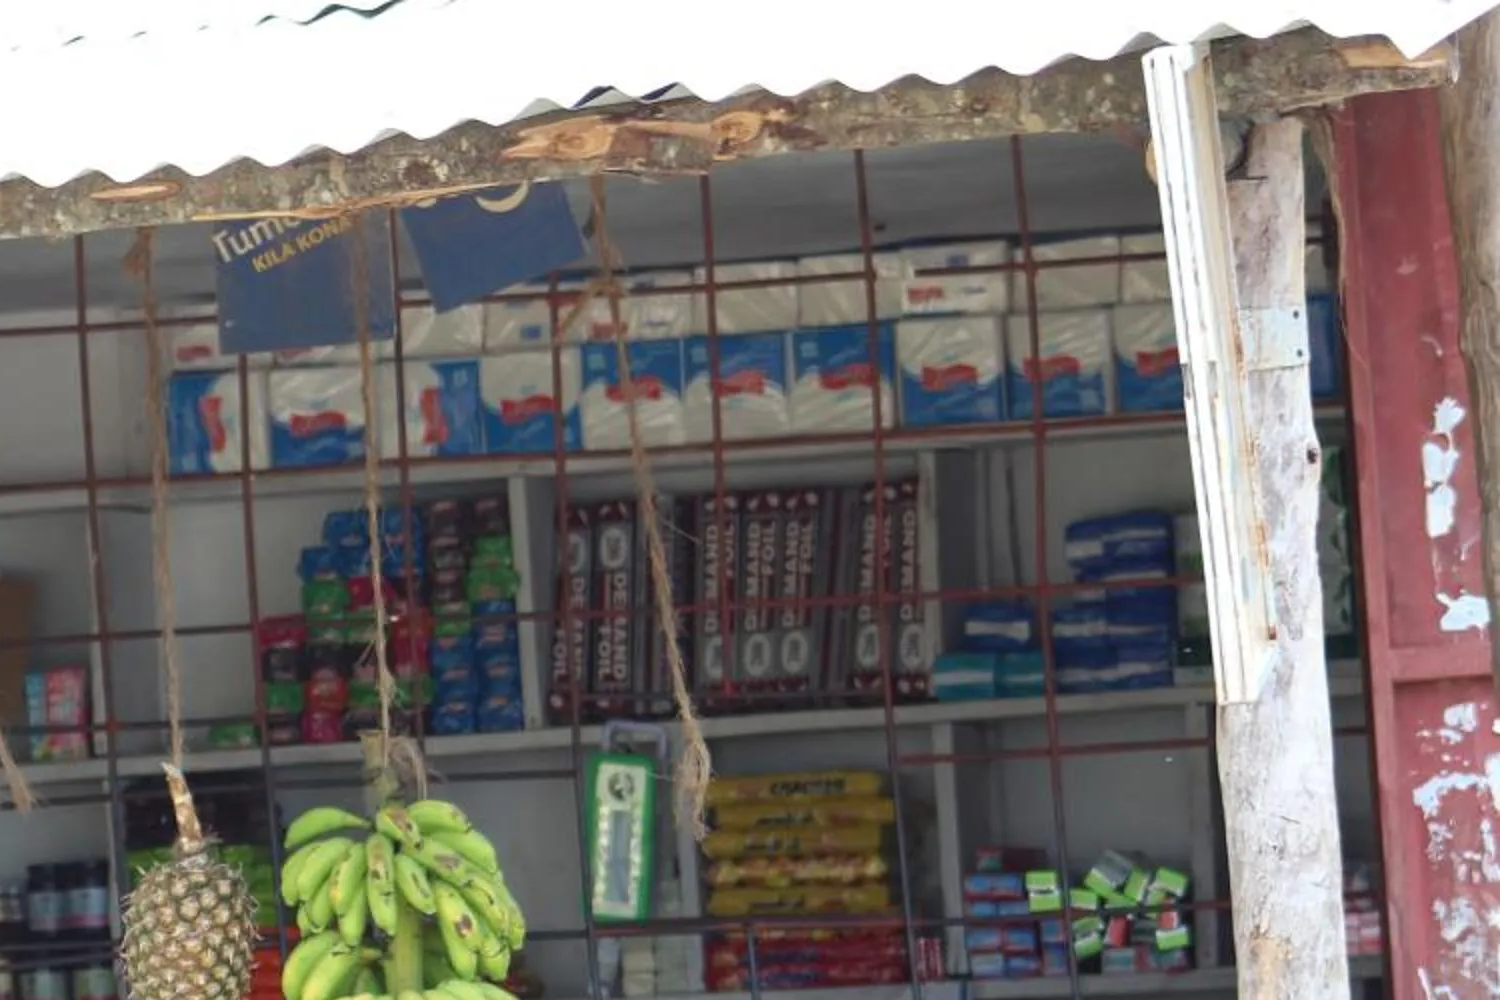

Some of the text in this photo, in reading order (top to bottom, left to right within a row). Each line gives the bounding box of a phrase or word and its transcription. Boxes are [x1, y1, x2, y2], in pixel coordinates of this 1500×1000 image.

[251, 241, 297, 273] KILA
[704, 524, 719, 633] DMAND
[744, 521, 761, 631] DMAND
[761, 520, 776, 576] FOIL
[782, 521, 799, 628] DMAND
[858, 514, 875, 622] DMAND
[901, 510, 915, 620] DMAND
